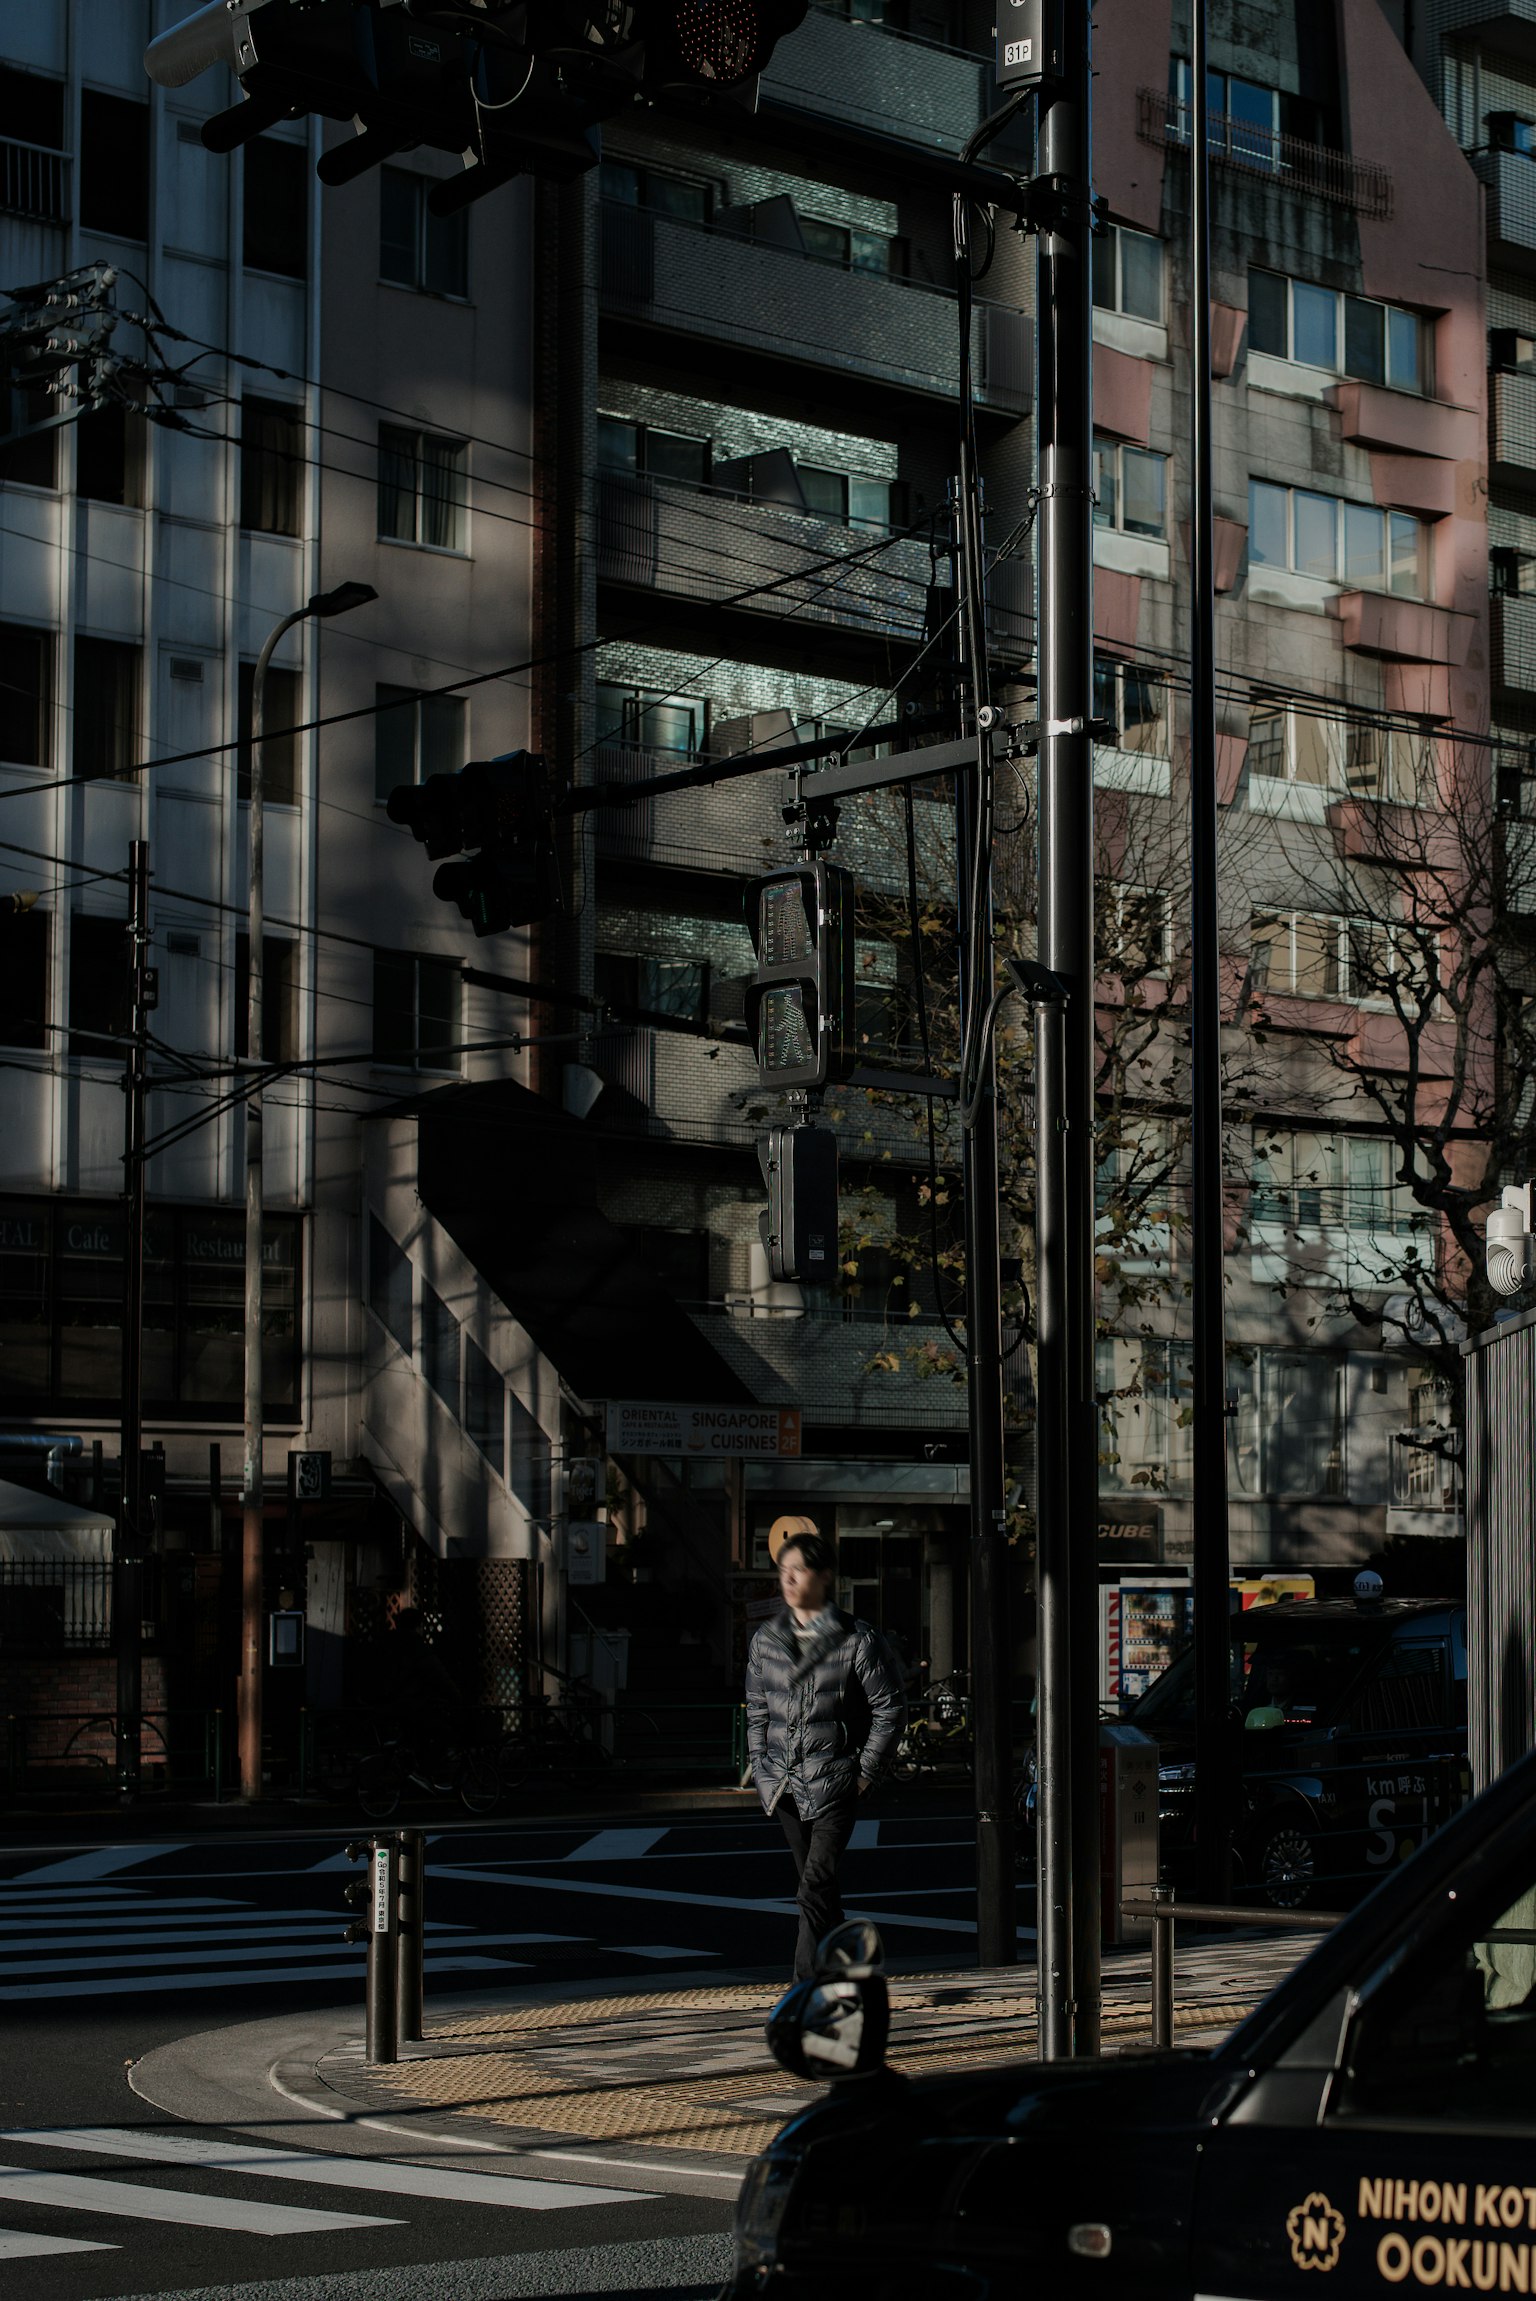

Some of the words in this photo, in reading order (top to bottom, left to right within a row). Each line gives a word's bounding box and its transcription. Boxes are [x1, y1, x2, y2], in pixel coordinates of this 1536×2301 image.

[67, 1224, 110, 1251] Cafe
[185, 1232, 281, 1261] Restaunt
[622, 1409, 678, 1422] ORIENTAL
[692, 1412, 777, 1429] SINGAPORE
[711, 1434, 777, 1450] CUISINES
[782, 1436, 797, 1450] 2F
[1097, 1524, 1154, 1538] CUBE
[1316, 1792, 1336, 1804] TAXI
[1357, 2176, 1468, 2226] NIHON
